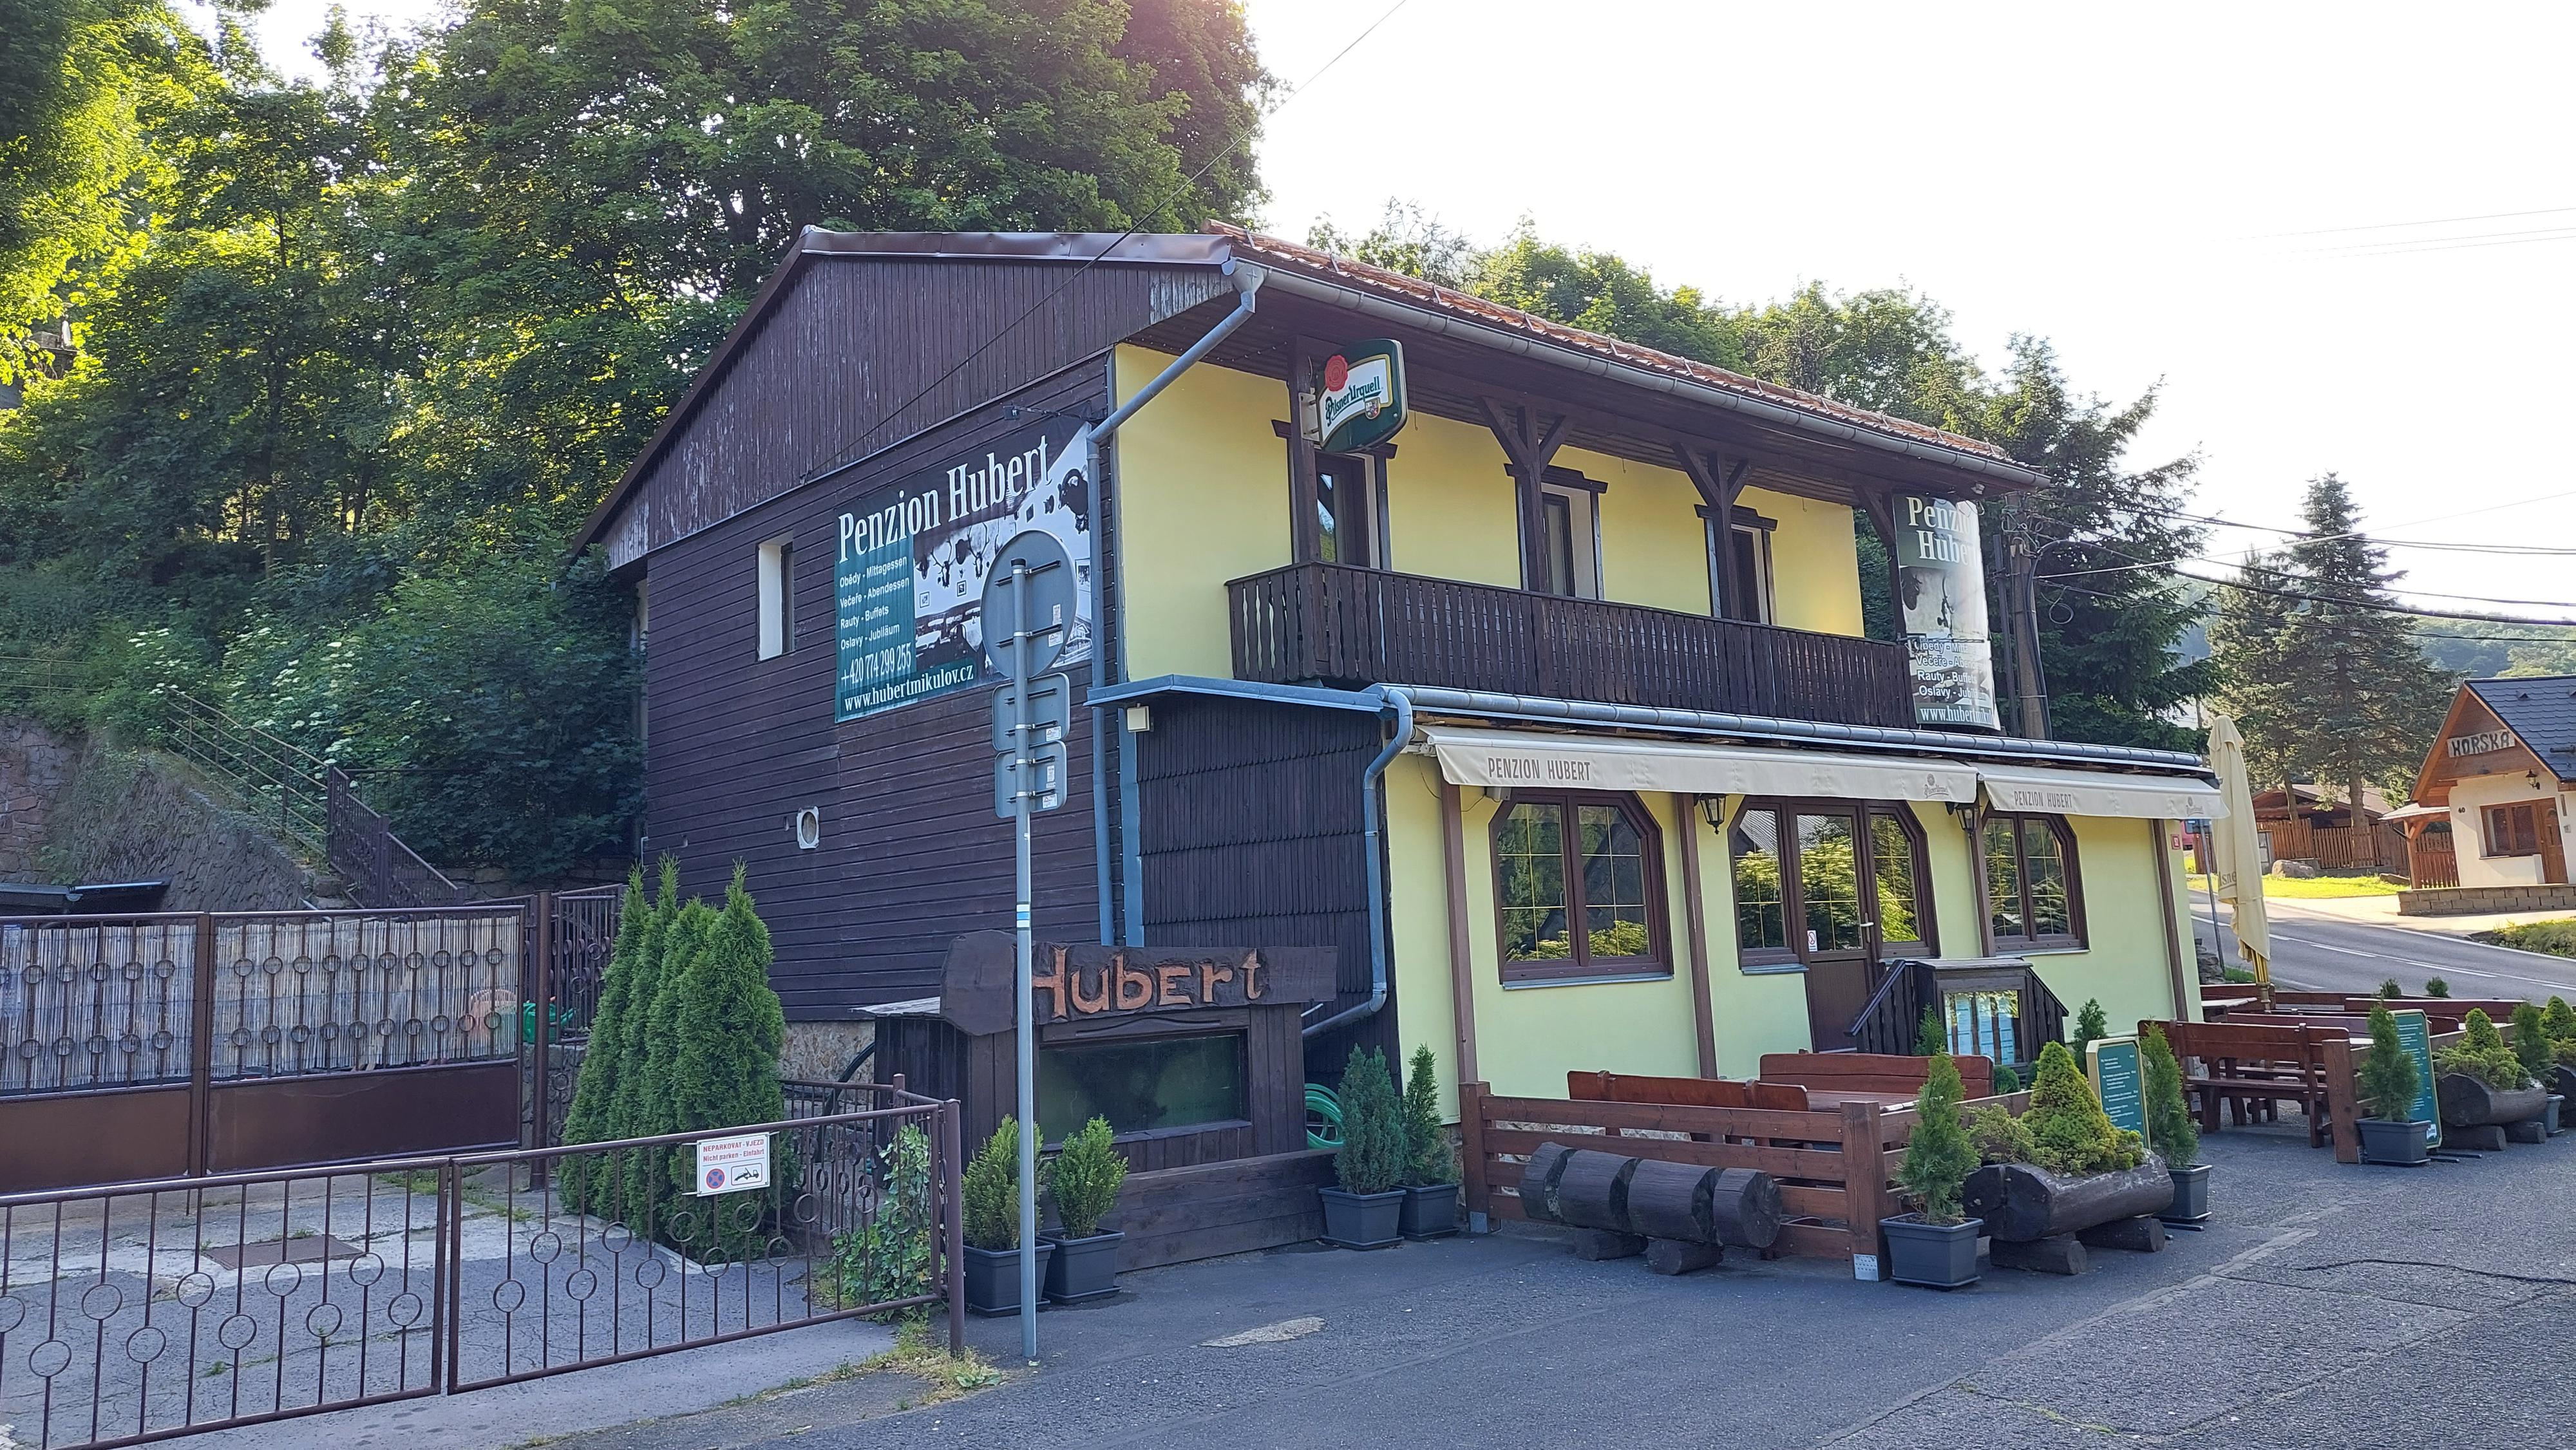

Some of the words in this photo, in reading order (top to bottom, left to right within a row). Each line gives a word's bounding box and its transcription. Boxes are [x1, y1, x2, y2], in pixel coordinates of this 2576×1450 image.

[1325, 393, 1350, 427] Pilsner
[1349, 376, 1381, 400] Urquell
[838, 490, 941, 563] Penzion
[947, 435, 1053, 522] Hubert
[840, 572, 861, 588] Obědy
[866, 556, 907, 579] Mittagessen
[840, 592, 862, 608] Večeře
[867, 578, 909, 599] Abendessen
[840, 615, 860, 630] Rauty
[865, 605, 889, 622] Buffets
[840, 636, 864, 650] Oslavy
[869, 624, 900, 641] Jubiläum
[841, 655, 864, 686] +420
[865, 652, 879, 681] 774
[880, 647, 895, 675] 299
[897, 642, 912, 671] 255
[1917, 670, 1944, 683] Rauty
[844, 664, 974, 711] www.hubertmikulov.cz
[1919, 685, 1951, 699] Oslavy
[1488, 757, 1540, 779] PENZION
[1547, 760, 1590, 781] HUBERT
[2014, 791, 2043, 806] PENZION
[2047, 793, 2072, 808] HUBERT
[2219, 871, 2237, 887] lsne
[703, 1142, 742, 1153] NEPARKOVAT
[746, 1138, 764, 1147] VJEZD
[719, 1153, 739, 1161] parken
[743, 1149, 764, 1157] Einfahrt
